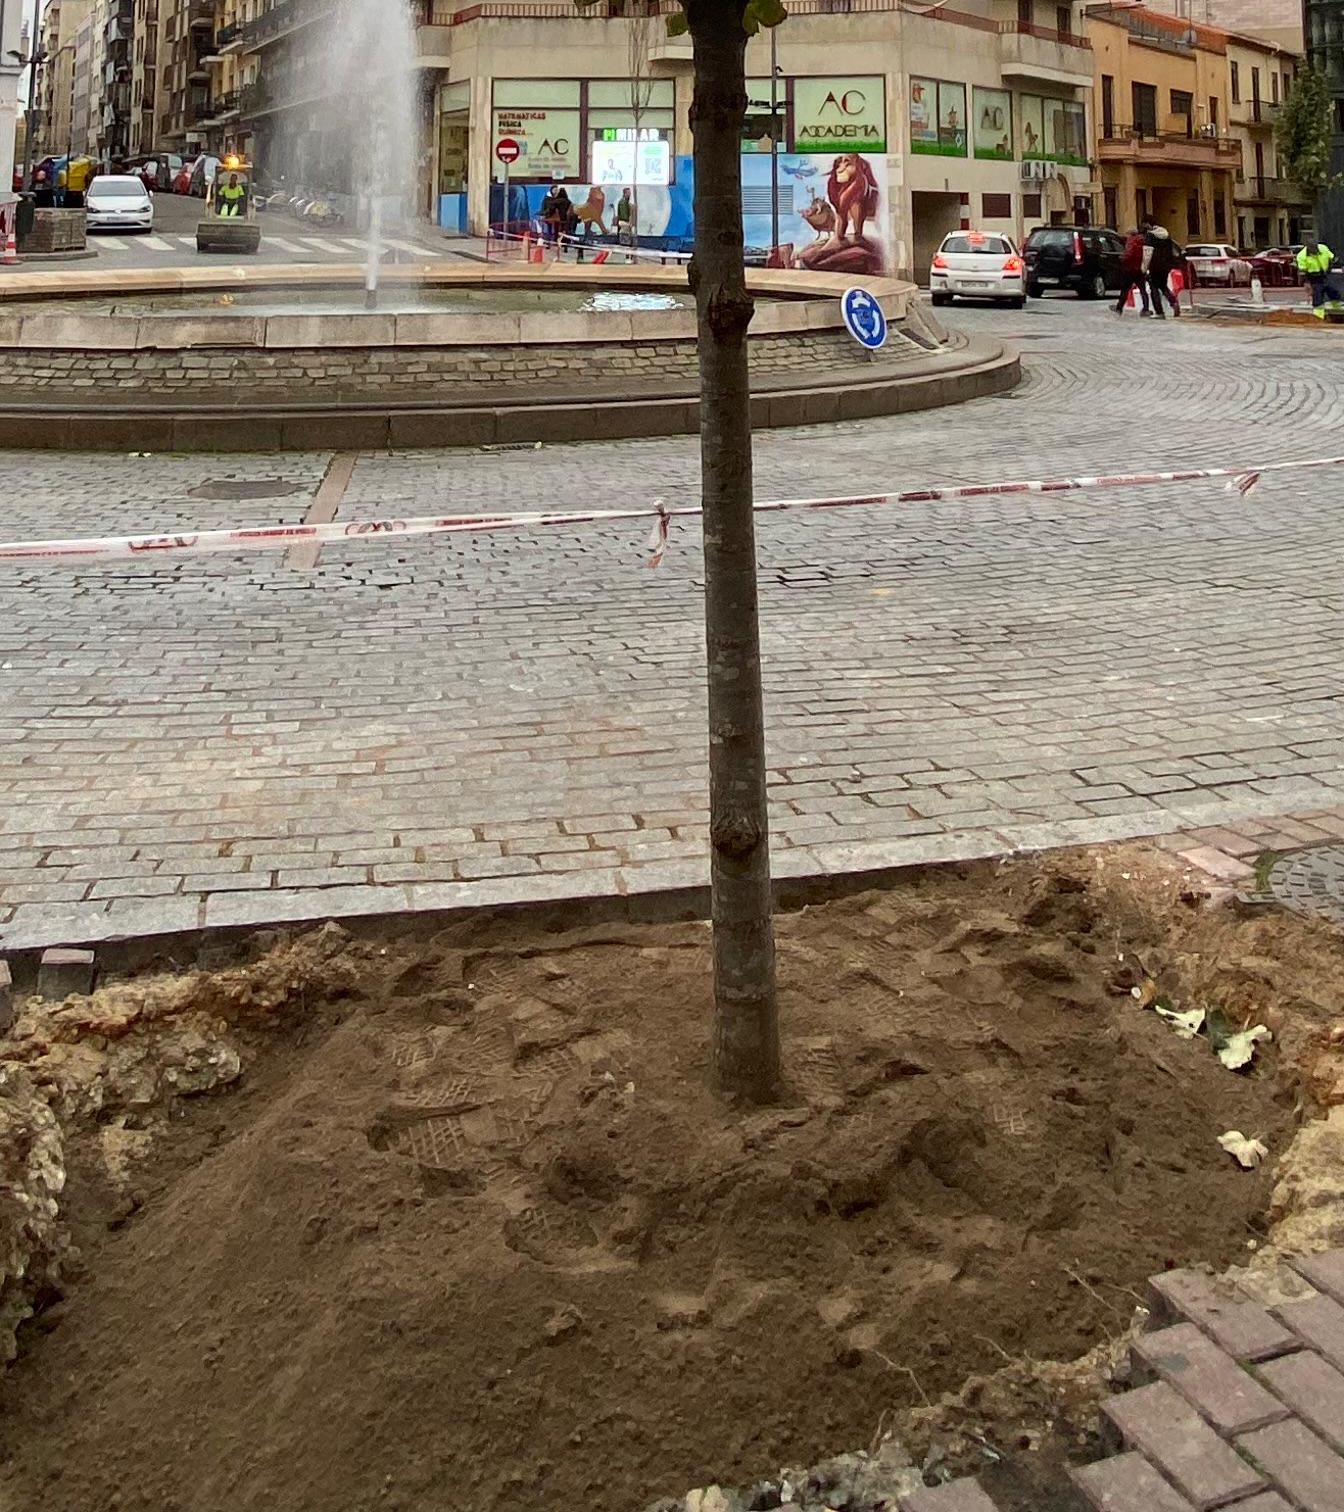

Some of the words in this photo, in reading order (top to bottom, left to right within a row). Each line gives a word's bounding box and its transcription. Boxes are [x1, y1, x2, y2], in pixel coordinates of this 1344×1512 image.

[818, 90, 866, 116] AC
[981, 106, 1003, 130] AC
[537, 137, 570, 156] AC
